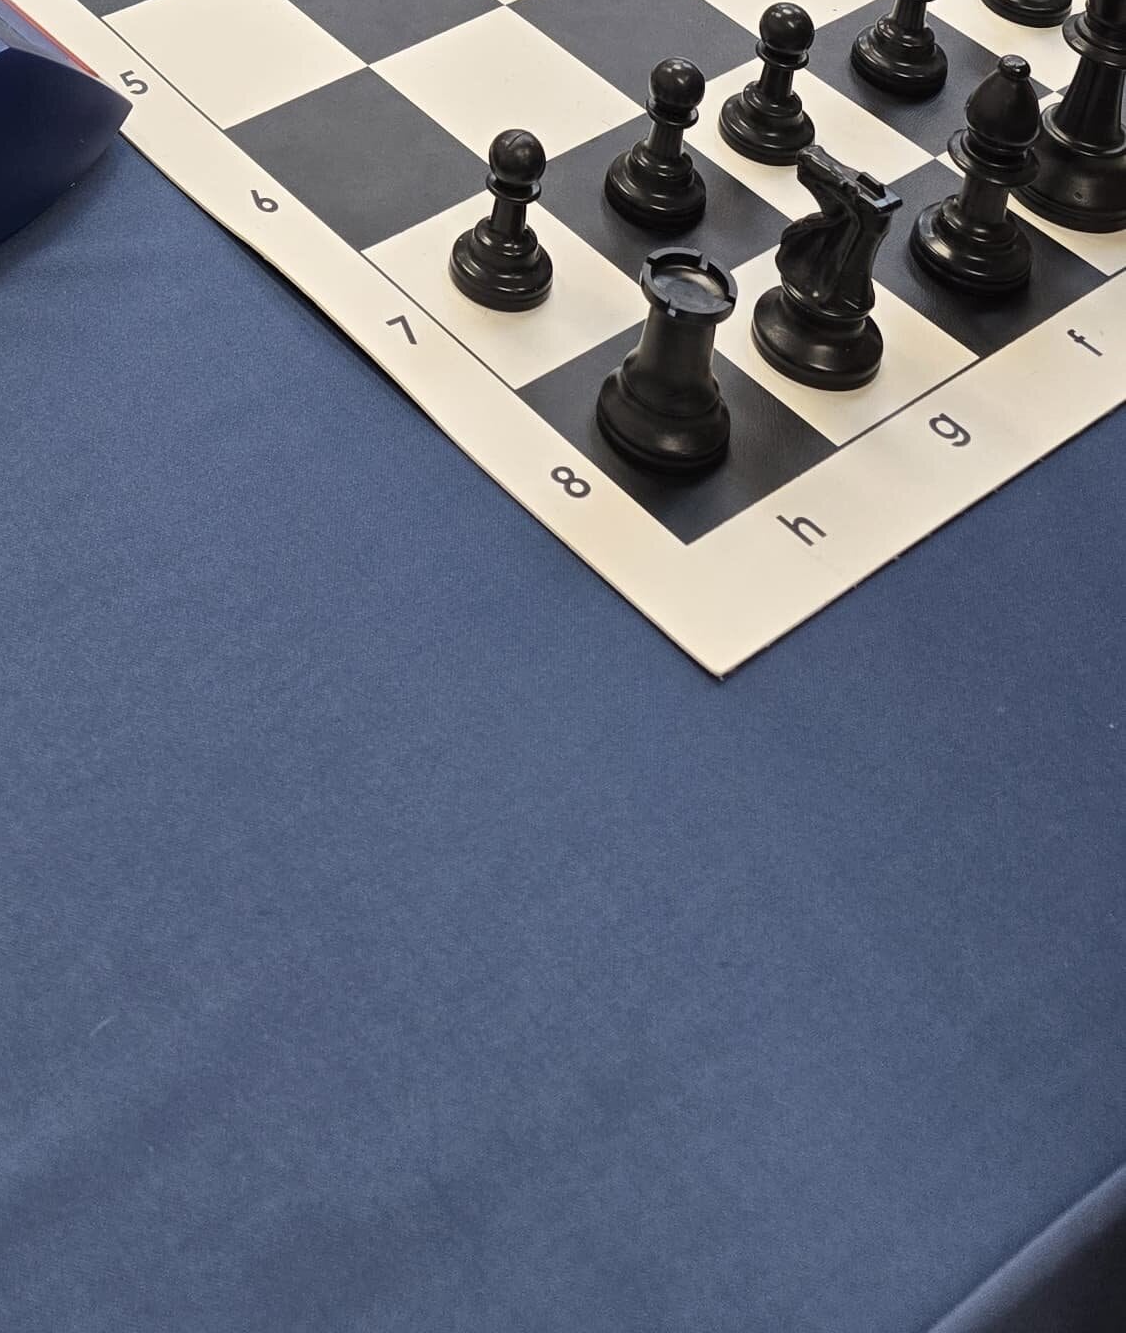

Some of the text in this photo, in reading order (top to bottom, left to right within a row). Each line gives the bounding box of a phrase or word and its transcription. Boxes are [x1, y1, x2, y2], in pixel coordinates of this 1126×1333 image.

[121, 69, 150, 96] 5
[250, 188, 280, 214] 6
[385, 314, 418, 346] 7
[549, 464, 592, 500] 8
[775, 328, 1103, 547] f g h
